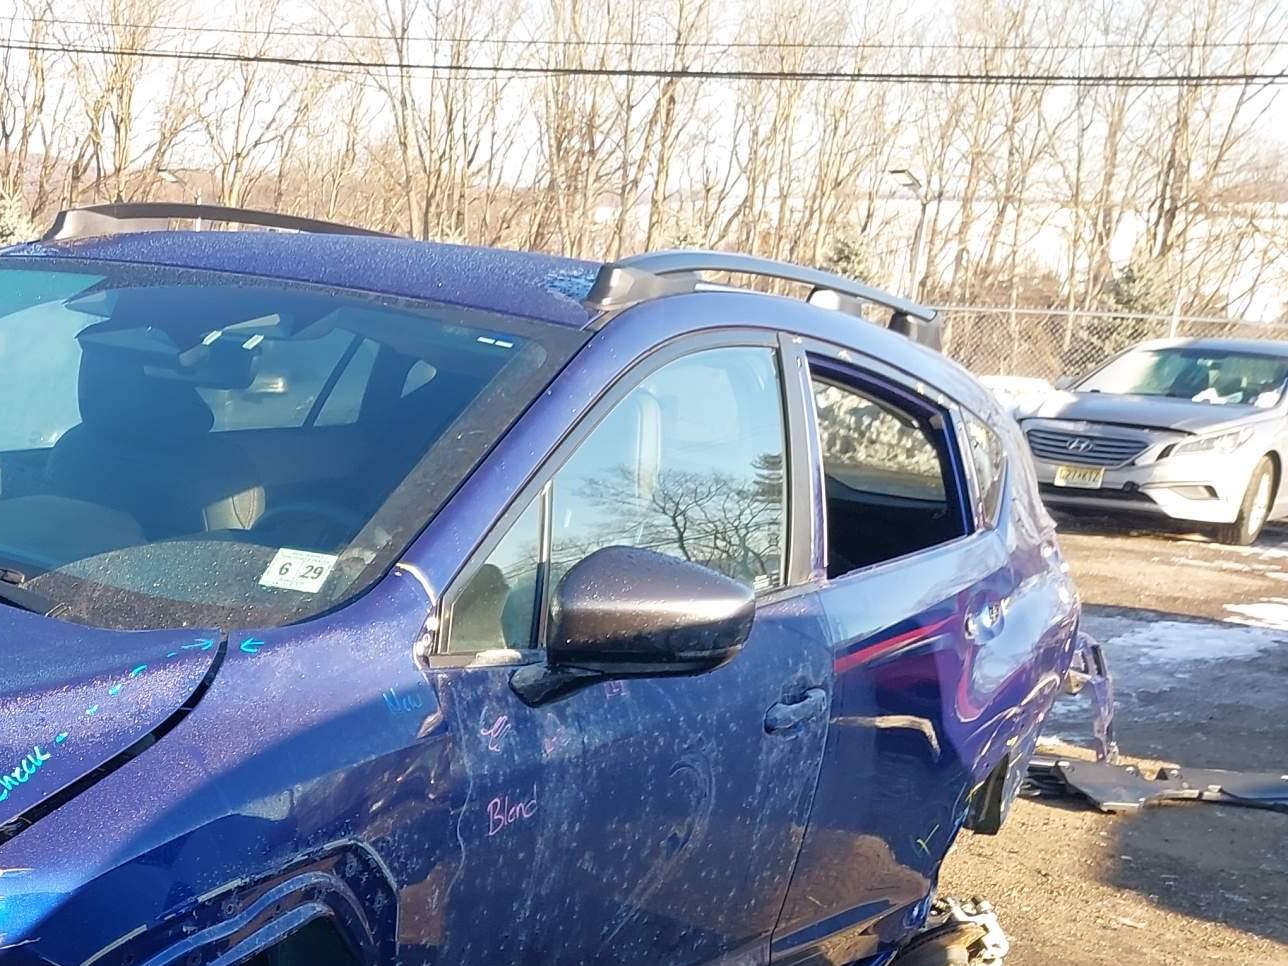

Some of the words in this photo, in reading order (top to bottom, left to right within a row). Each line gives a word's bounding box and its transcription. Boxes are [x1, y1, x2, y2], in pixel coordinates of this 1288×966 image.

[279, 562, 292, 576] 6
[299, 565, 324, 580] 29
[487, 782, 538, 837] Blend
